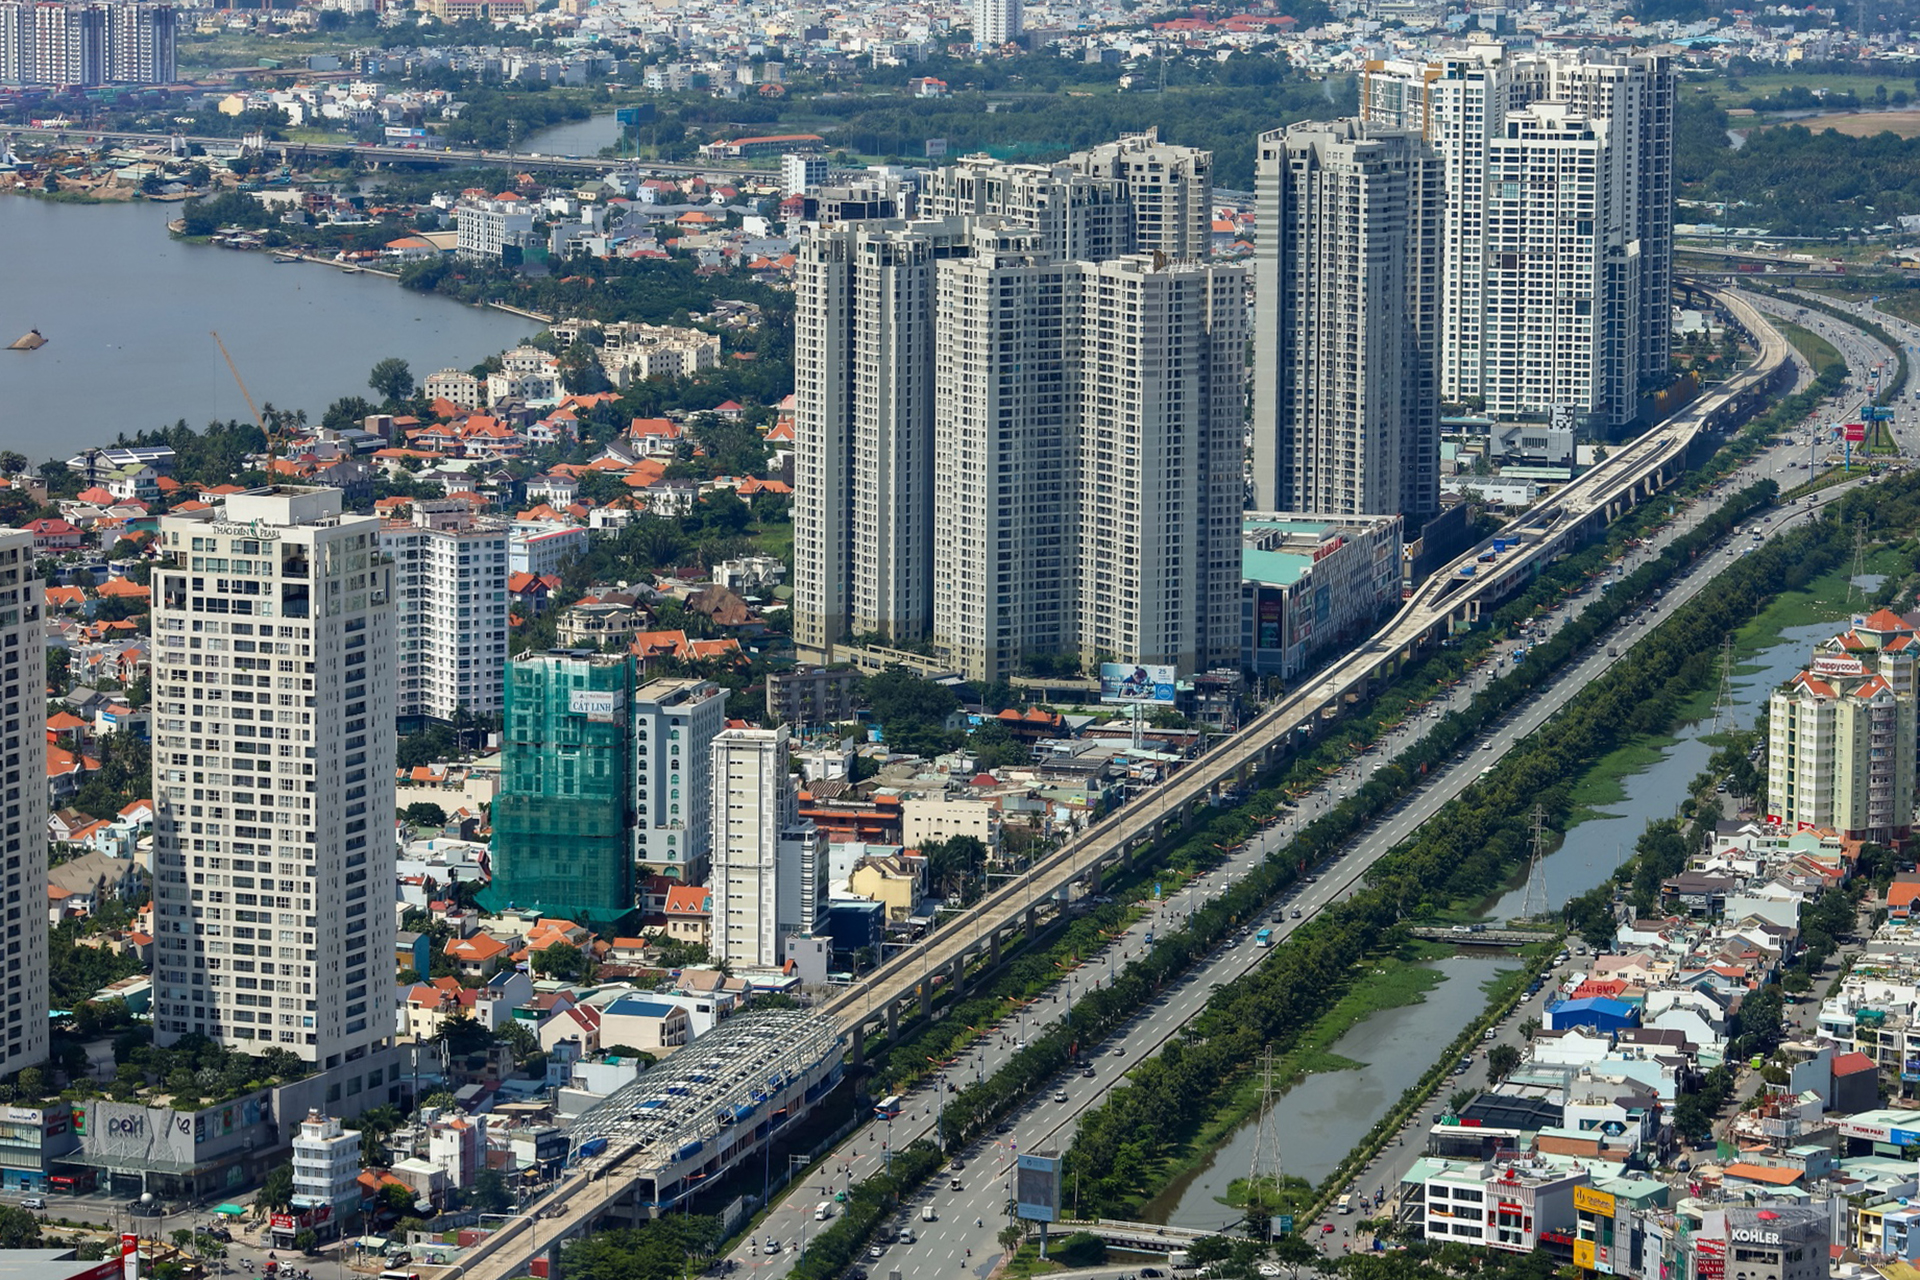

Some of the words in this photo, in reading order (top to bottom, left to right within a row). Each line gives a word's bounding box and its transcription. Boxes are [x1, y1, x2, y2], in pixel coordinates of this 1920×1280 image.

[260, 528, 280, 538] PEARL
[573, 699, 590, 711] CÁT
[591, 702, 611, 712] LINH
[1731, 1228, 1780, 1245] KOHLER
